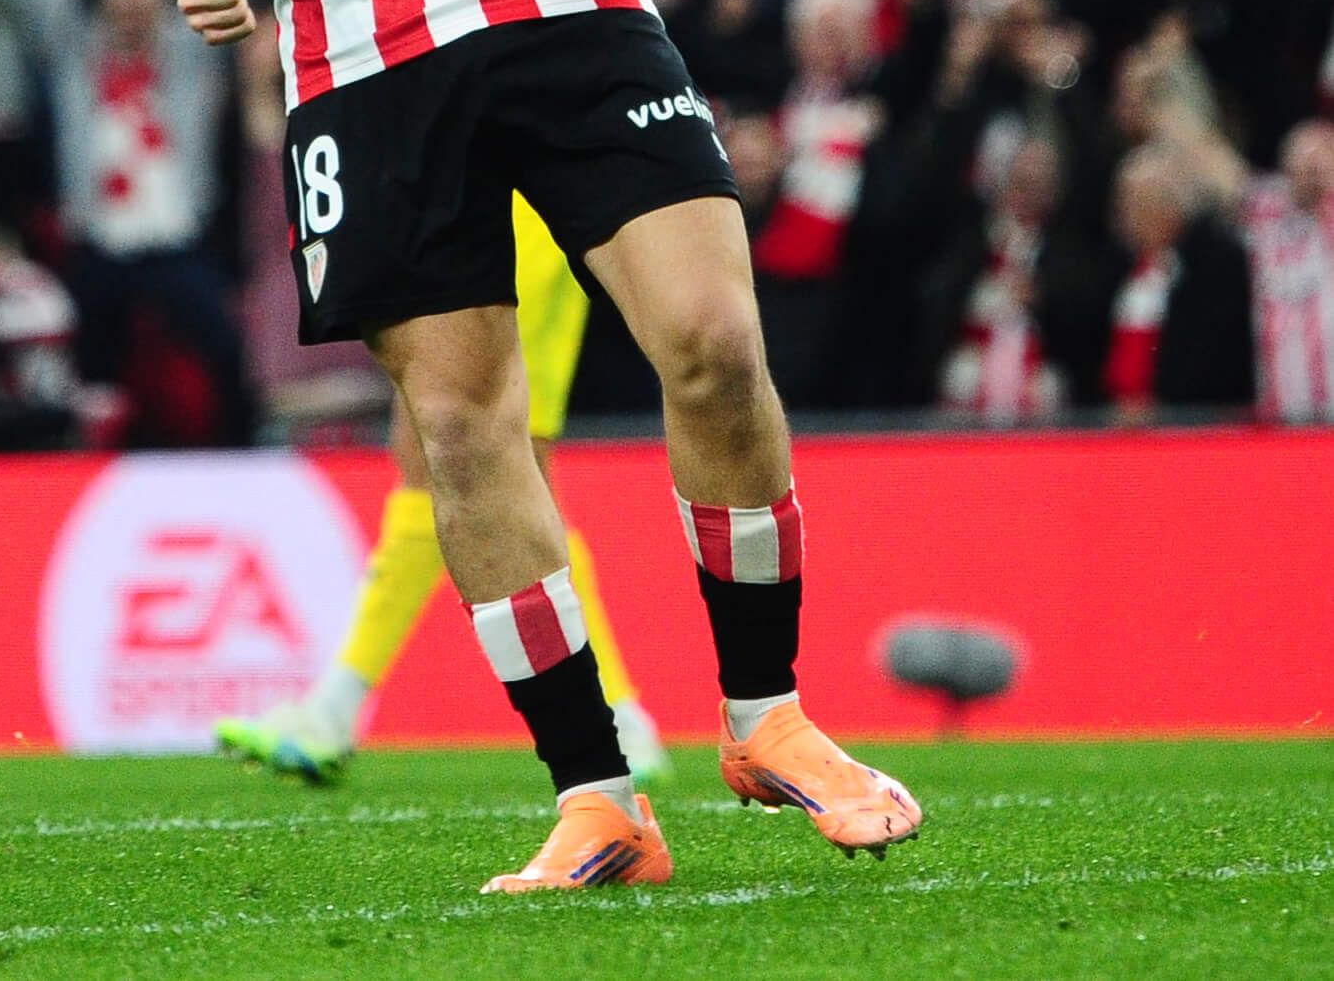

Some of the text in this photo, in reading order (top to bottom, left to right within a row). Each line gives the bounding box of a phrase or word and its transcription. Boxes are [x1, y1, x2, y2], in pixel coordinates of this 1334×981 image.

[626, 85, 715, 129] vuelin
[291, 134, 344, 241] 18
[121, 526, 308, 653] EA
